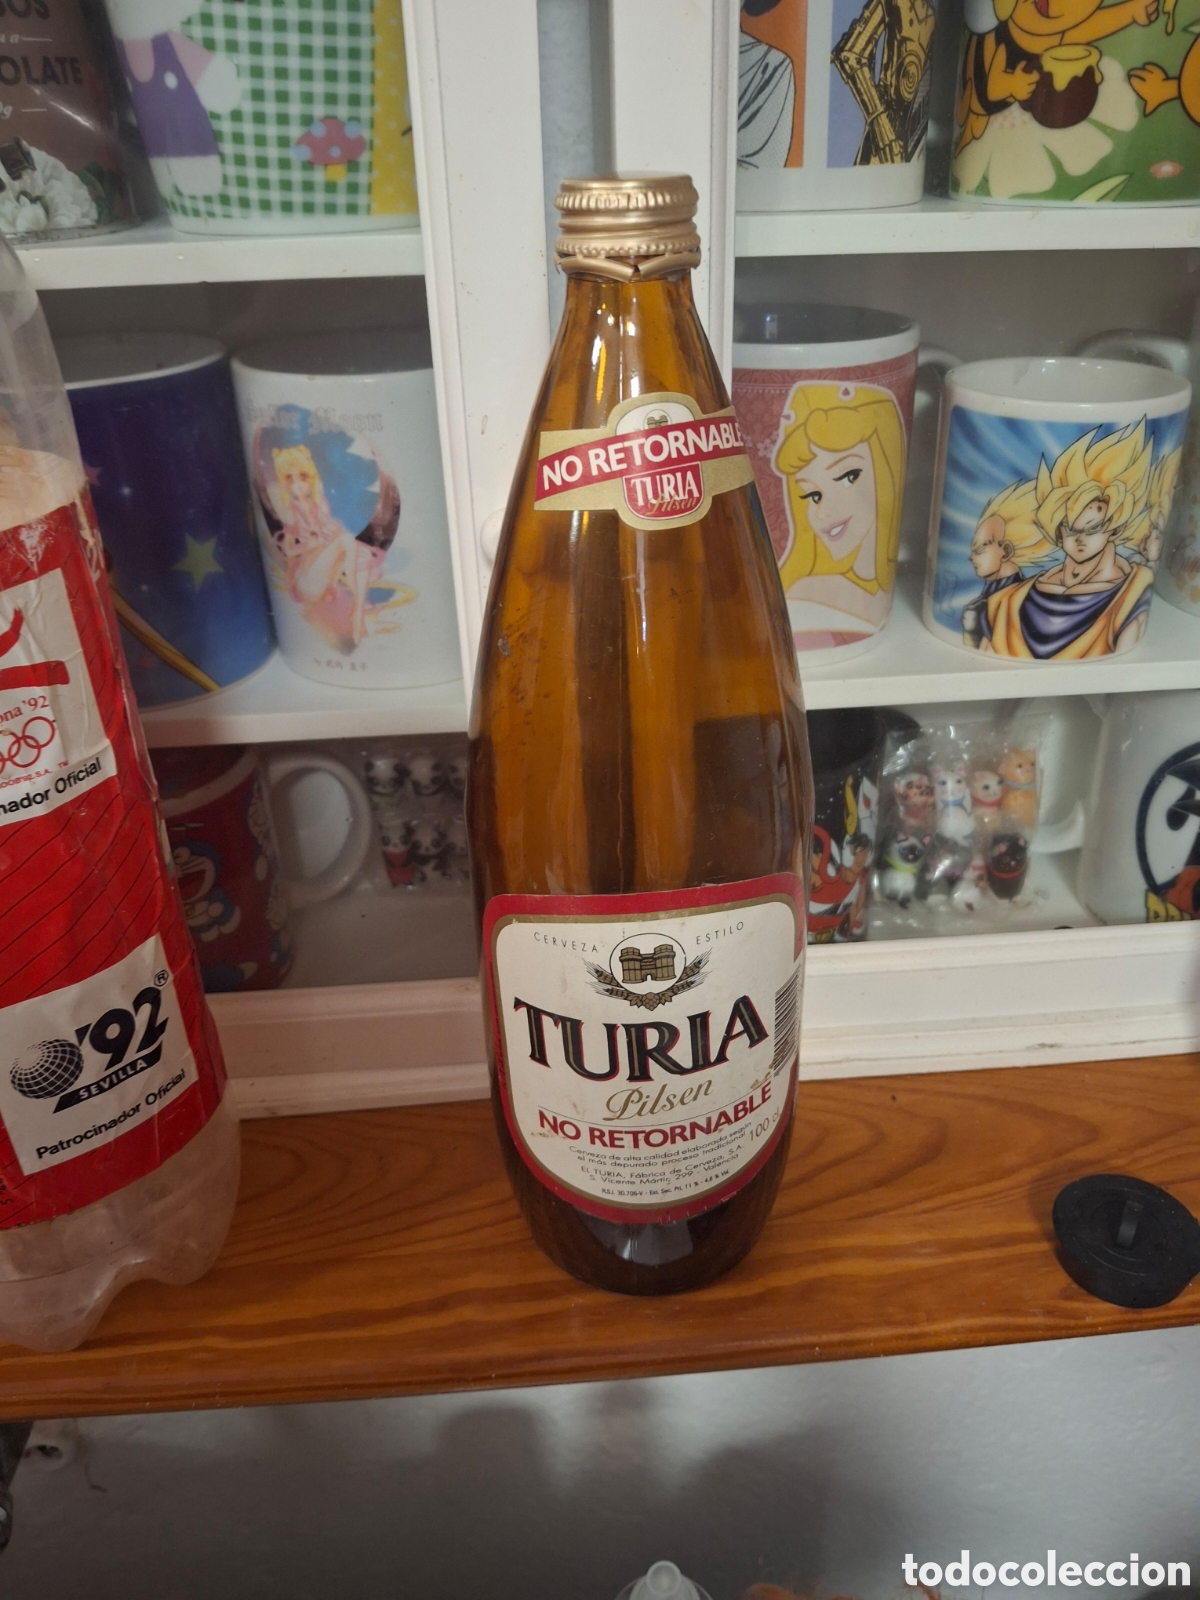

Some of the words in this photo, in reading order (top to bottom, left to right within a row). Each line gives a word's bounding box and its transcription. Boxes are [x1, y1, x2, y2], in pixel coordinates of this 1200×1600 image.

[542, 455, 583, 491] NO
[588, 422, 744, 477] RETORNABLE
[630, 470, 699, 506] TURIA
[646, 493, 698, 516] Pilsen
[54, 757, 103, 794] Oficial
[533, 931, 599, 953] CERVEZA
[696, 921, 745, 945] ESTILO
[75, 986, 169, 1072] '92
[514, 995, 769, 1082] TURIA
[78, 1059, 149, 1101] SEVILLA
[36, 1102, 142, 1160] Patrocinador
[145, 1068, 186, 1106] Oficial
[538, 1109, 581, 1141] NO
[588, 1080, 773, 1149] RETORNABLE
[602, 1079, 713, 1121] Pilsen
[569, 1145, 607, 1159] Cerveza
[623, 1154, 641, 1162] alta
[643, 1149, 680, 1161] calidad
[681, 1134, 728, 1155] elaborada
[749, 1117, 770, 1141] 100
[588, 1158, 607, 1166] más
[610, 1160, 657, 1169] depurado
[661, 1153, 699, 1167] proceso
[702, 1130, 746, 1156] tradicional
[580, 1165, 591, 1173] EL
[630, 1170, 666, 1179] Fábrica
[601, 1176, 636, 1185] Vicente
[675, 1170, 694, 1180] 299
[703, 1153, 739, 1172] Valencia
